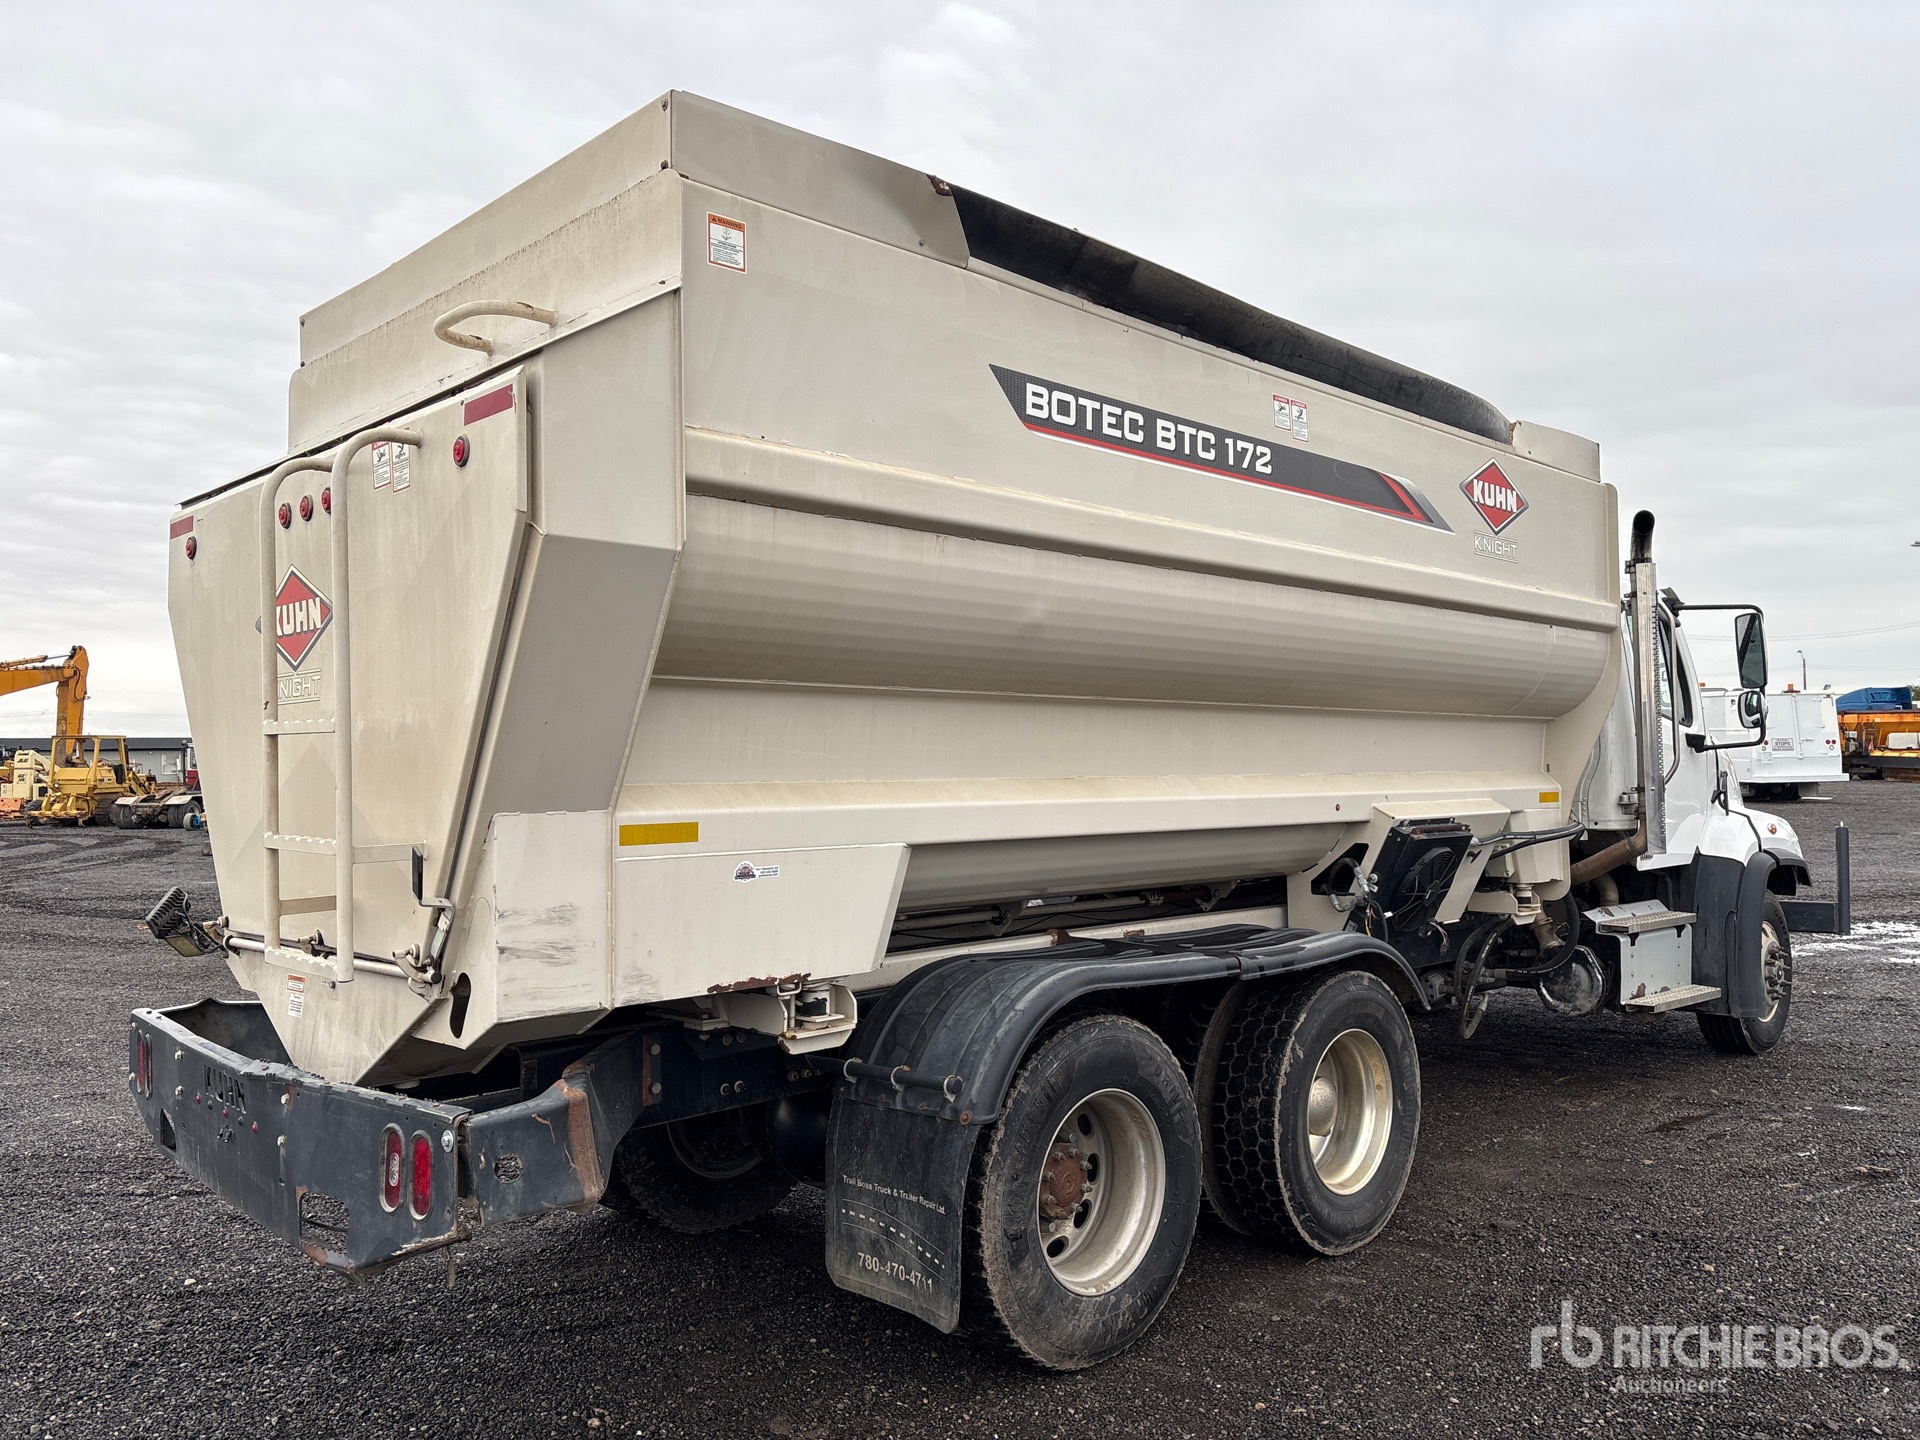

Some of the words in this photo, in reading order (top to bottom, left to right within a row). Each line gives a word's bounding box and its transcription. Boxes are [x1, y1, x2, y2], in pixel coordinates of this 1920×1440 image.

[1025, 382, 1144, 444] BOTEC
[1156, 418, 1216, 461] BTC
[1224, 437, 1273, 475] 172
[1472, 478, 1518, 513] KUHN
[1474, 535, 1518, 559] KNIGHT
[277, 674, 321, 699] NIGHT
[842, 1174, 856, 1186] Trail
[857, 1178, 873, 1191] Boss
[874, 1183, 892, 1196] Truck
[892, 1188, 898, 1197] &
[899, 1190, 919, 1203] Trailer
[919, 1195, 936, 1210] Repair
[936, 1202, 947, 1215] Ltd.
[857, 1251, 934, 1294] 780-470-4711
